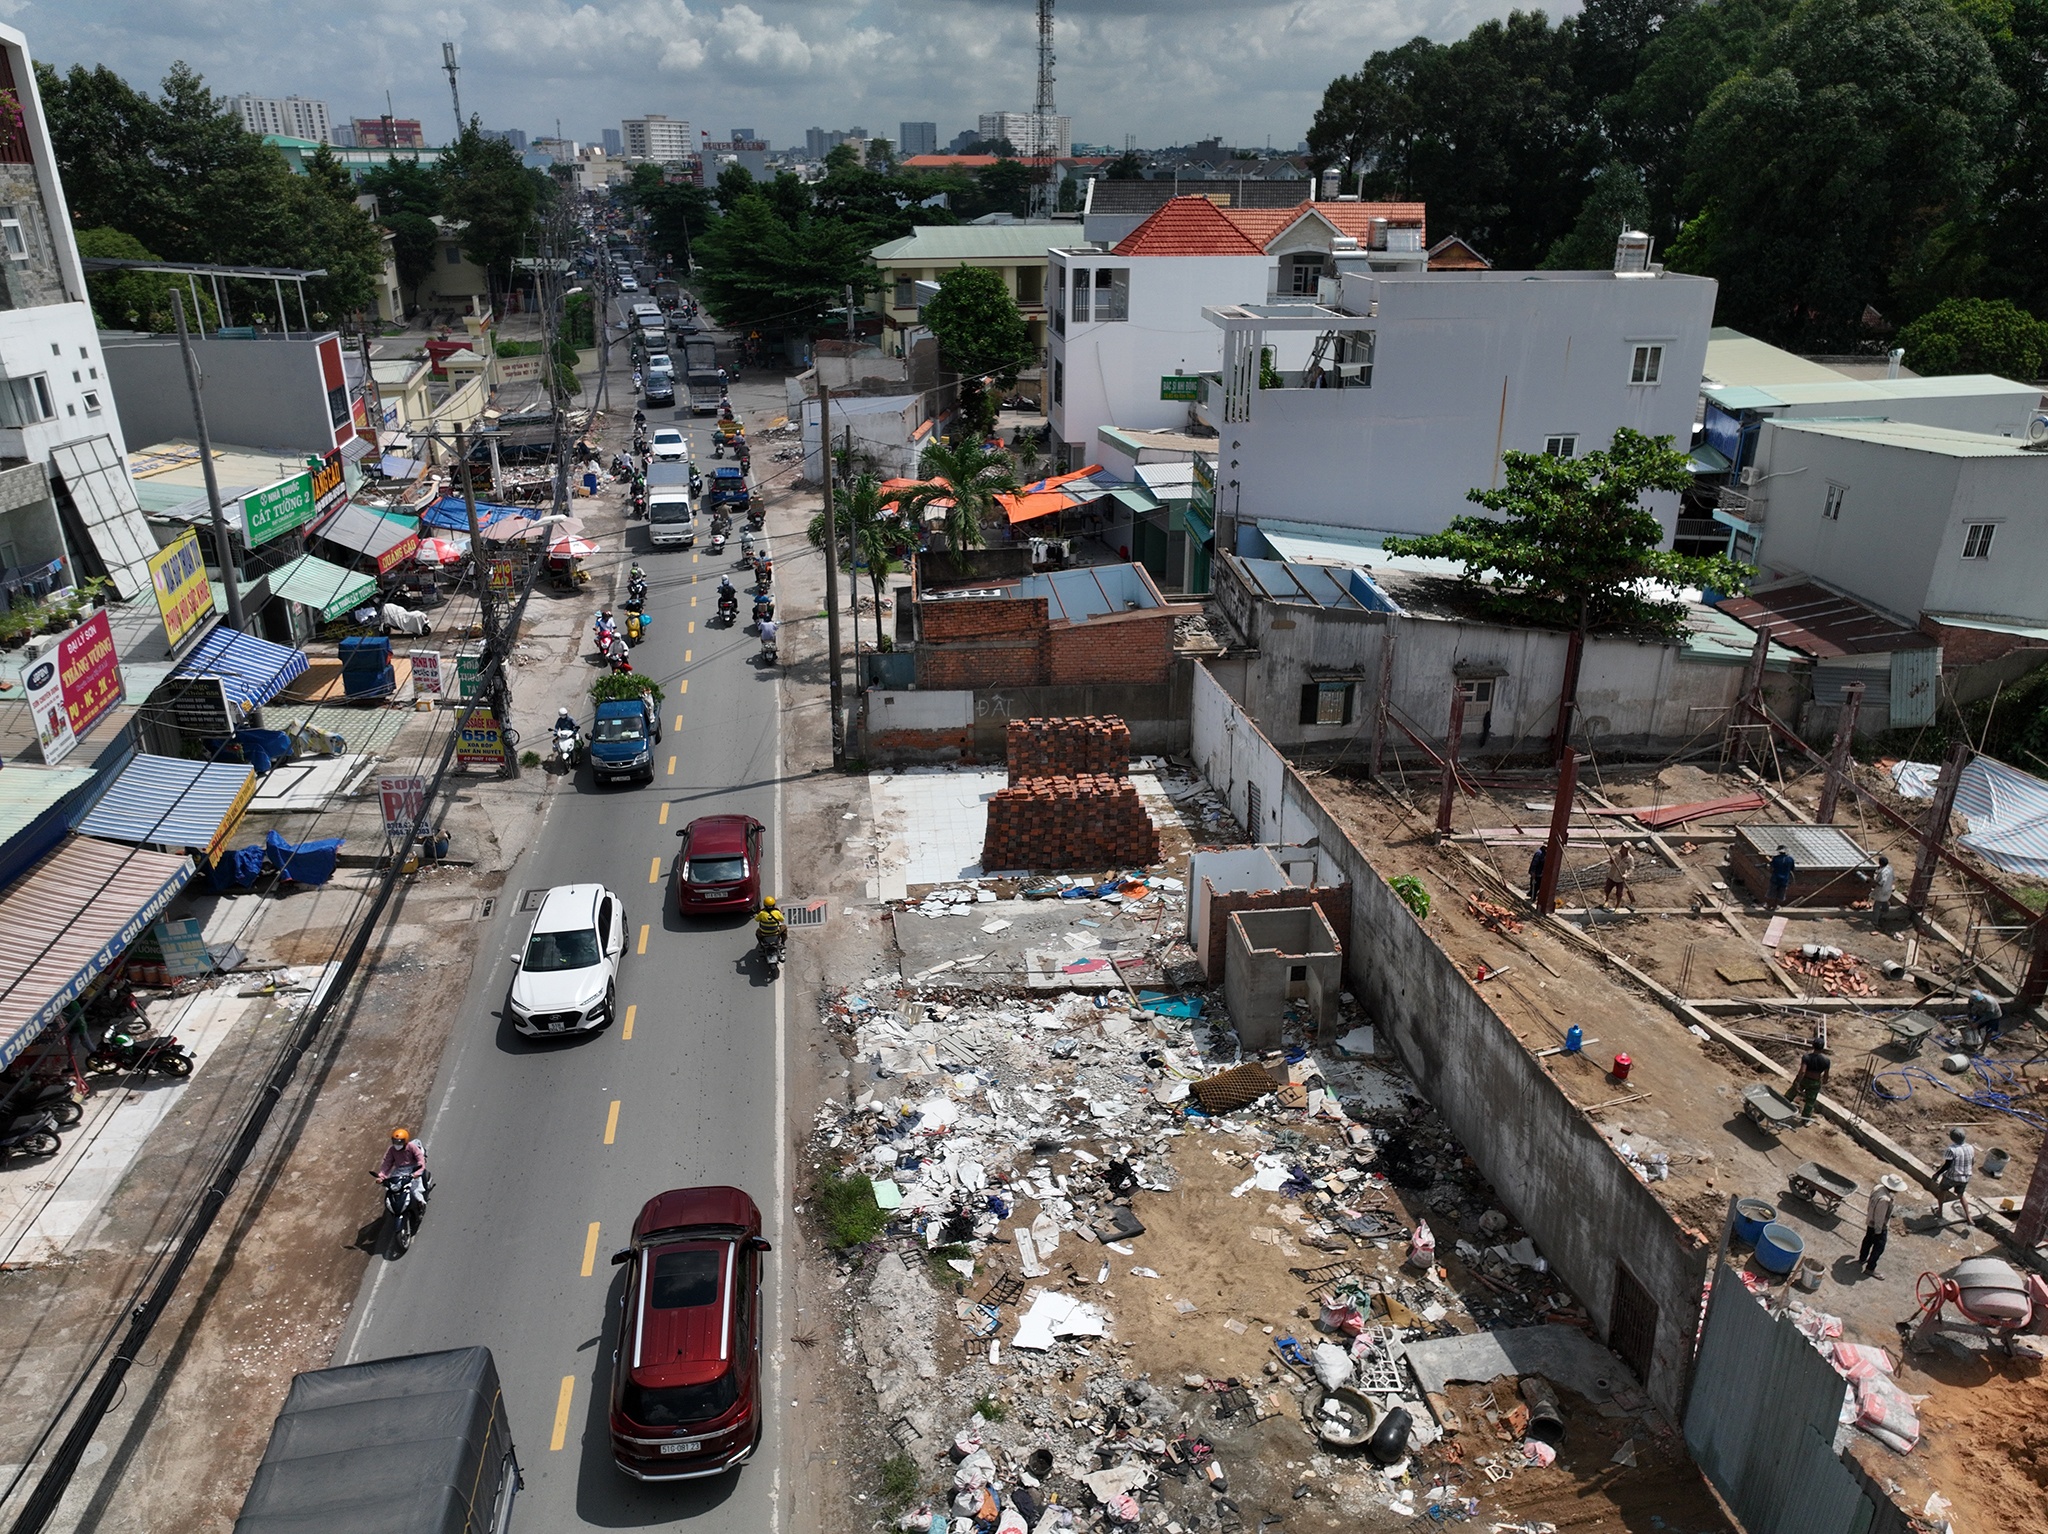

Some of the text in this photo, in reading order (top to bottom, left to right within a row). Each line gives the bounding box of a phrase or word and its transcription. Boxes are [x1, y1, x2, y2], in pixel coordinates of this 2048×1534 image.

[252, 508, 272, 527] CÁT
[273, 494, 302, 518] TƯỜNG
[304, 491, 310, 503] 2
[66, 624, 97, 655] ĐẠI LÝ SƠN
[412, 656, 437, 669] SINH TỐ
[68, 702, 79, 721] PU
[98, 677, 108, 695] 2K
[462, 729, 498, 742] 658
[381, 778, 421, 790] SƠN
[6, 1023, 42, 1060] PHỐI
[44, 992, 73, 1023] SƠN
[74, 966, 98, 992] GIÁ
[121, 918, 142, 944] CHI
[143, 879, 181, 919] NHÁNH
[180, 871, 188, 881] 1
